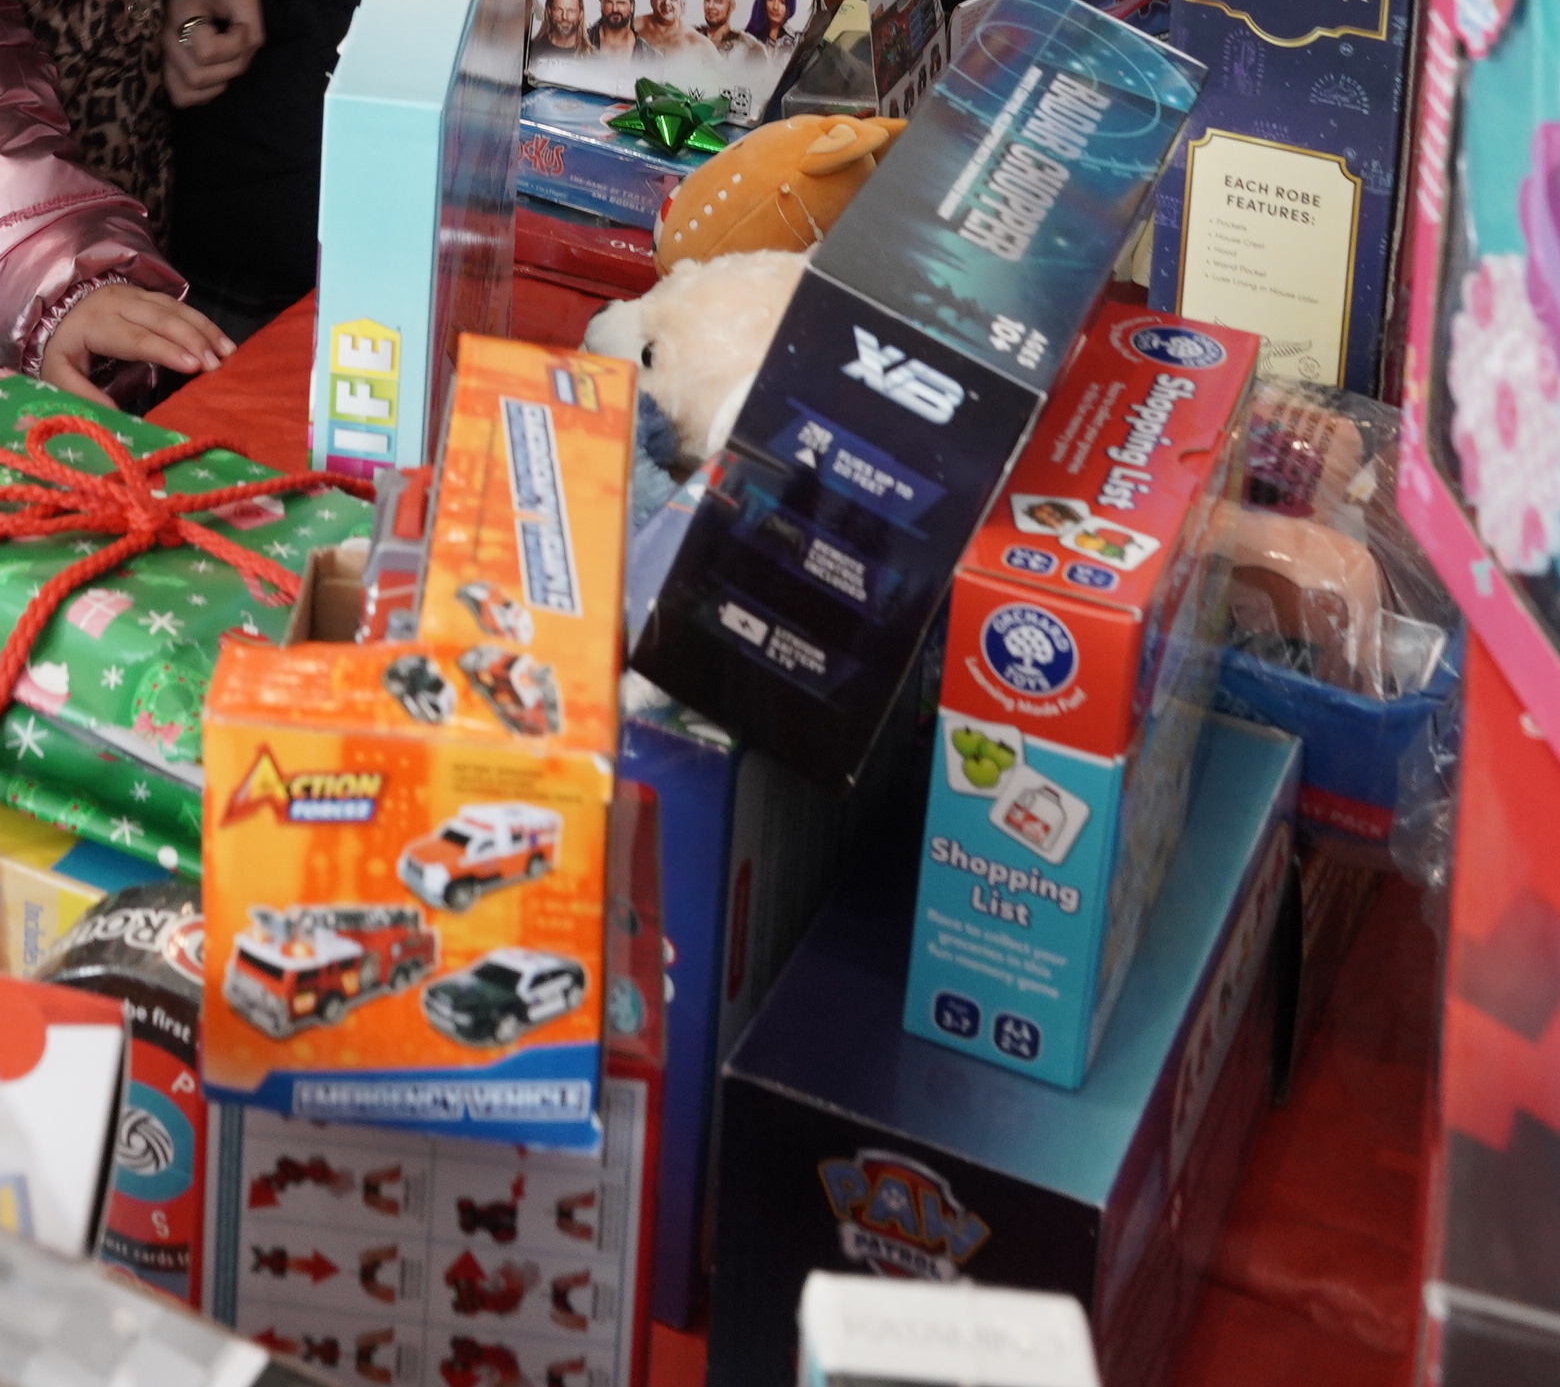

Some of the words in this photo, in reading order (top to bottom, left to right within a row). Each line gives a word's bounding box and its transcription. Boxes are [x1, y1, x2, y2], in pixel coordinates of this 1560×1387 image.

[1022, 71, 1112, 161] RADAR
[586, 179, 607, 192] GAME
[958, 142, 1071, 263] CHOPPER
[1224, 174, 1269, 196] EACH
[1275, 186, 1322, 208] ROBE
[1226, 194, 1316, 226] FEATURES:
[988, 313, 1027, 353] 10+
[1016, 327, 1050, 371] AGES
[1107, 372, 1197, 467] Shopping
[1097, 465, 1154, 510] List
[991, 607, 1071, 654] ORCHARD
[1003, 662, 1052, 692] TOYS
[222, 742, 385, 827] ACTION
[289, 798, 377, 822] FORCES
[930, 835, 1081, 914] Shopping
[970, 884, 1030, 927] List
[151, 1006, 192, 1047] first
[818, 1157, 990, 1263] PAW
[853, 1229, 946, 1281] PATROL
